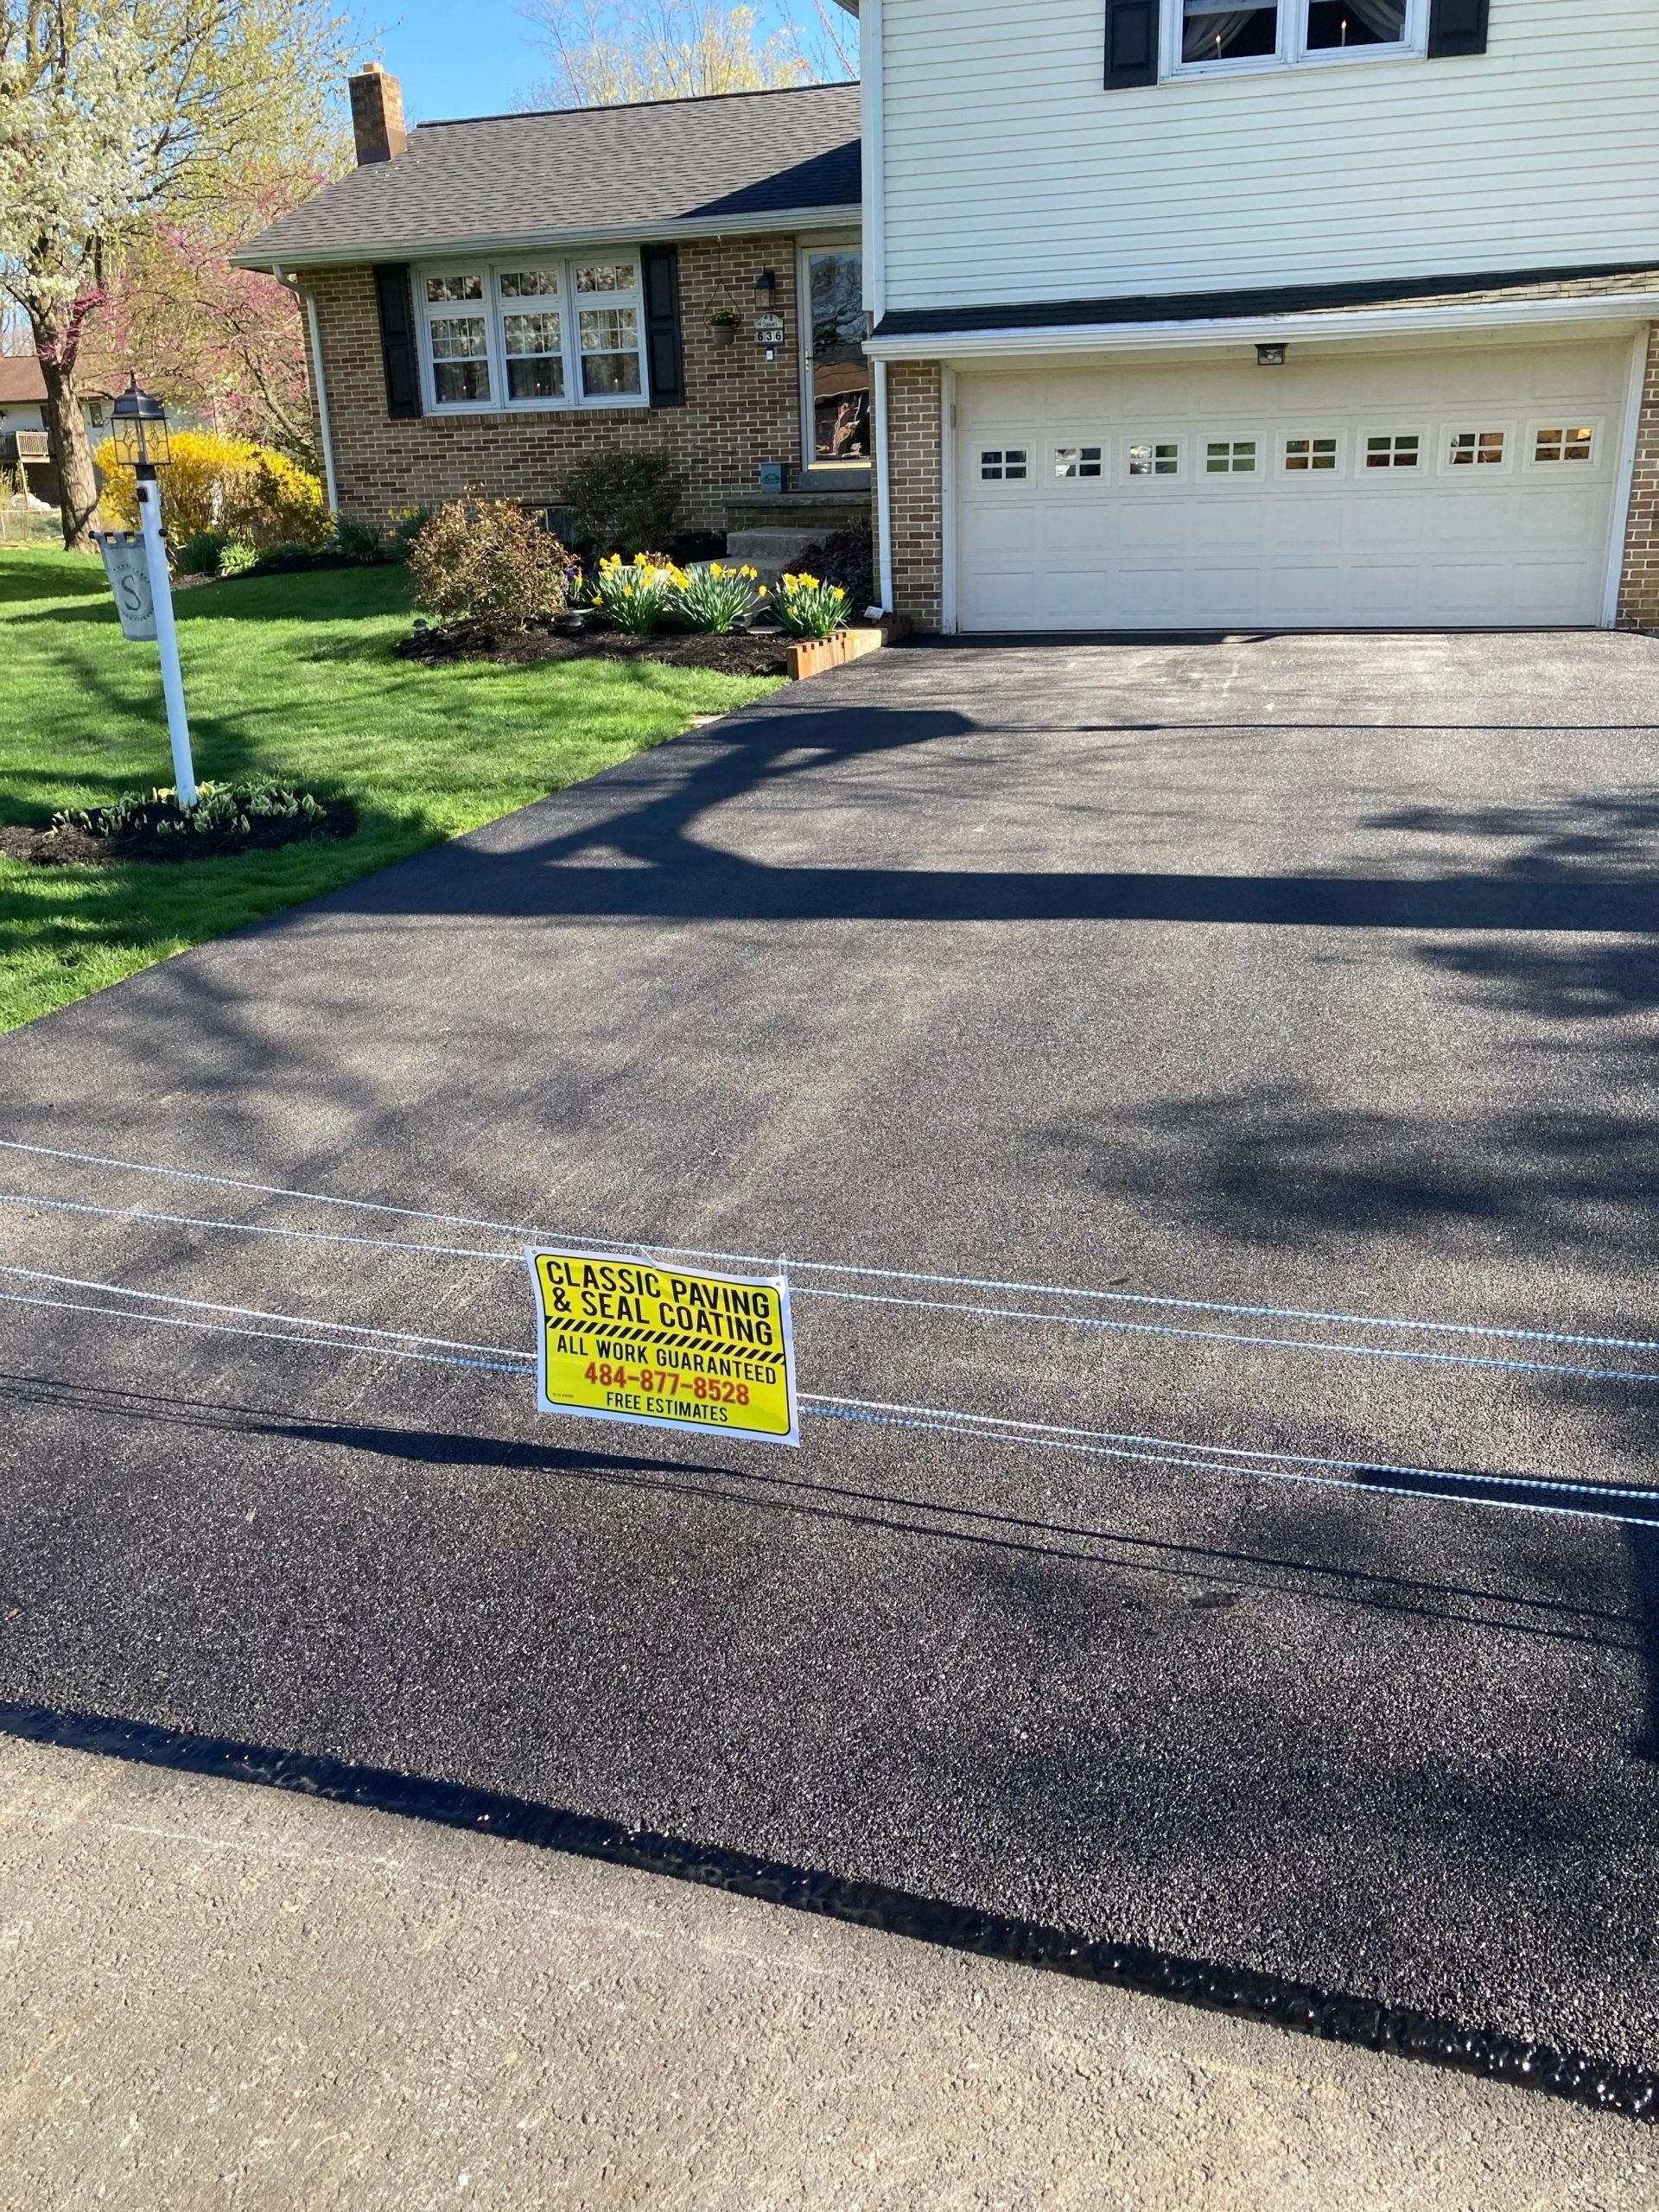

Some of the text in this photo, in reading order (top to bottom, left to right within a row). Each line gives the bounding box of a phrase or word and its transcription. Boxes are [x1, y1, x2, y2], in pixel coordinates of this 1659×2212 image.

[757, 331, 782, 341] 636
[121, 575, 142, 611] S
[546, 1261, 770, 1319] CLASSIC PAVING
[553, 1287, 773, 1346] & SEAL COATING
[557, 1335, 777, 1385] ALL WORK GUARANTEED
[585, 1361, 750, 1406] 484-877-8528
[607, 1391, 728, 1422] FREE ESTIMATES
